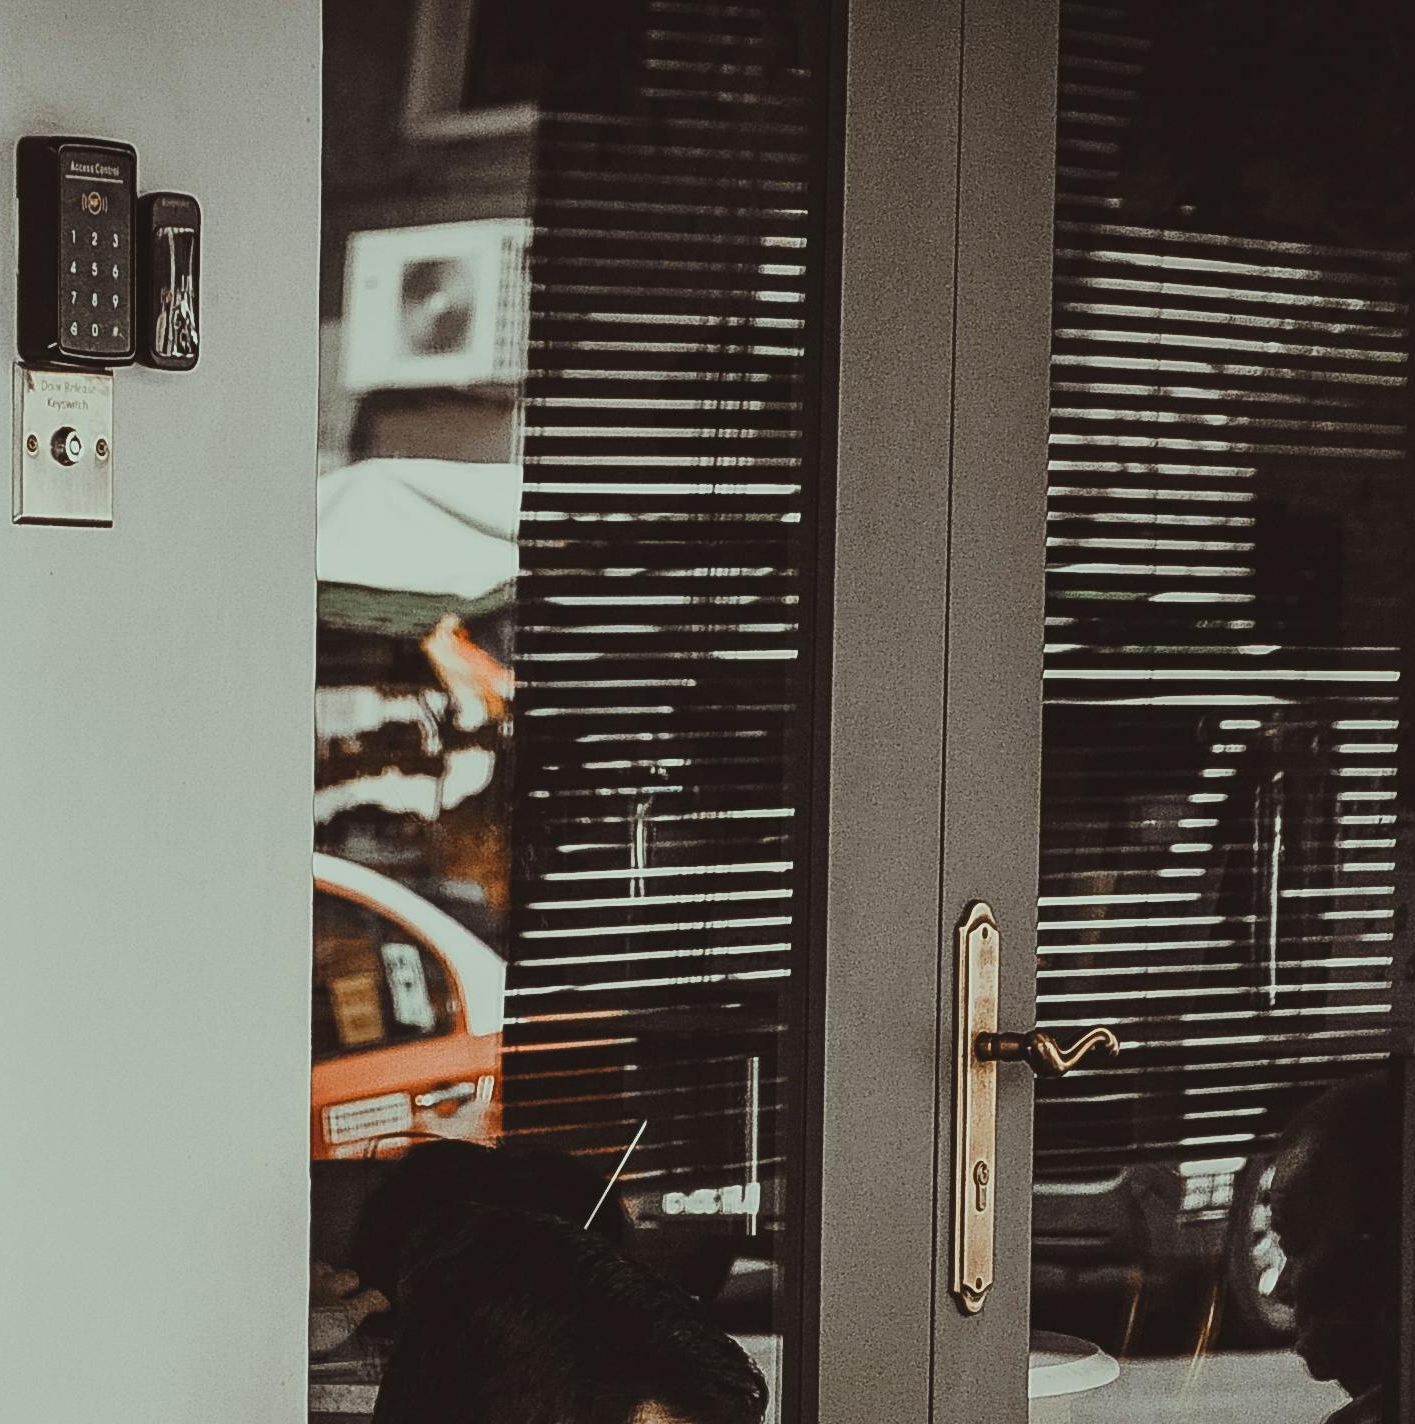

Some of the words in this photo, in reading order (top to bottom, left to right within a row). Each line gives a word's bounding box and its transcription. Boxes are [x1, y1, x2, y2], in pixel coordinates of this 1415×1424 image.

[70, 160, 94, 173] Access
[95, 163, 120, 176] Control
[71, 228, 77, 245] 1
[91, 231, 99, 247] 2
[112, 232, 119, 249] 3
[70, 260, 77, 274] 4
[91, 261, 99, 277] 5
[112, 264, 119, 280] 6
[70, 290, 78, 306] 7
[91, 292, 99, 308] 8
[112, 293, 119, 310] 9
[91, 323, 99, 338] 0
[41, 379, 61, 392] Door
